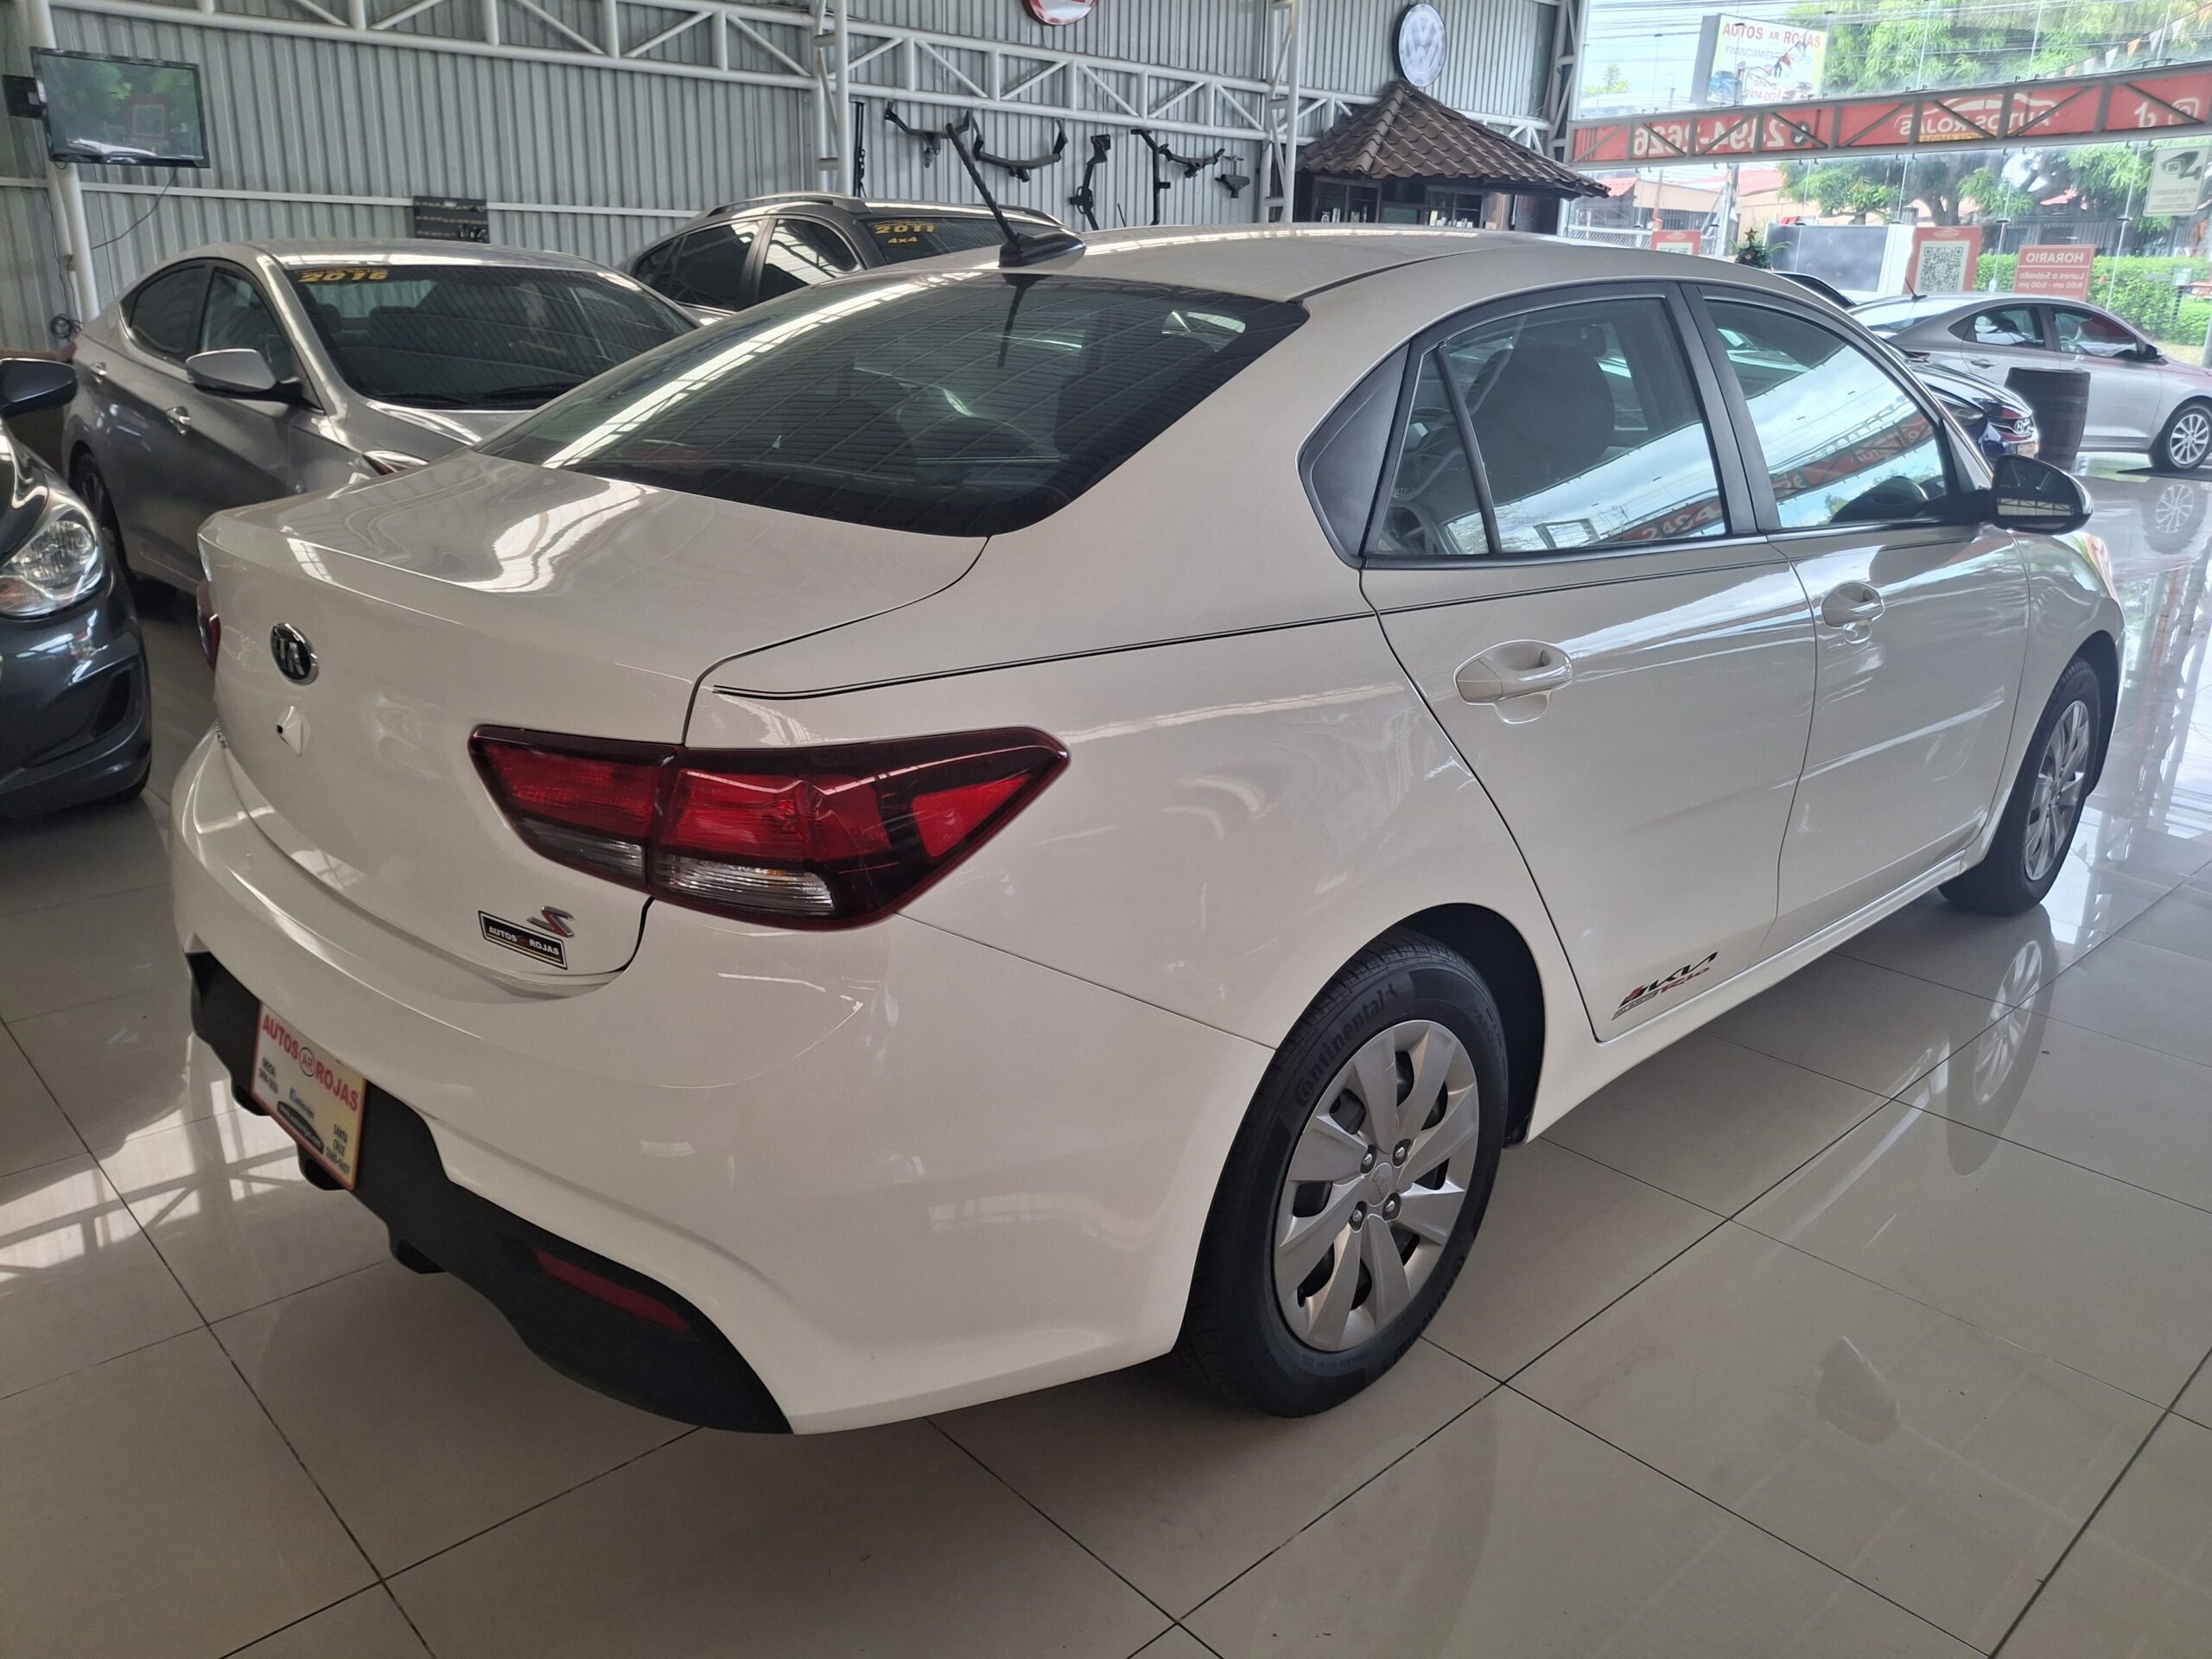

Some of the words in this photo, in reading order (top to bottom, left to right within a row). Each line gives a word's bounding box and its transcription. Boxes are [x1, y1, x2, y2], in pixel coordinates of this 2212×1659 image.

[1723, 22, 1764, 40] AUTOS
[1768, 31, 1780, 41] AR
[874, 223, 935, 234] 2011
[488, 926, 518, 943] AUTOS
[529, 939, 559, 956] ROJAS
[1297, 988, 1386, 1107] Continental
[262, 1014, 299, 1061] AUTOS
[301, 1051, 314, 1071] AR
[315, 1061, 359, 1112] ROJAS
